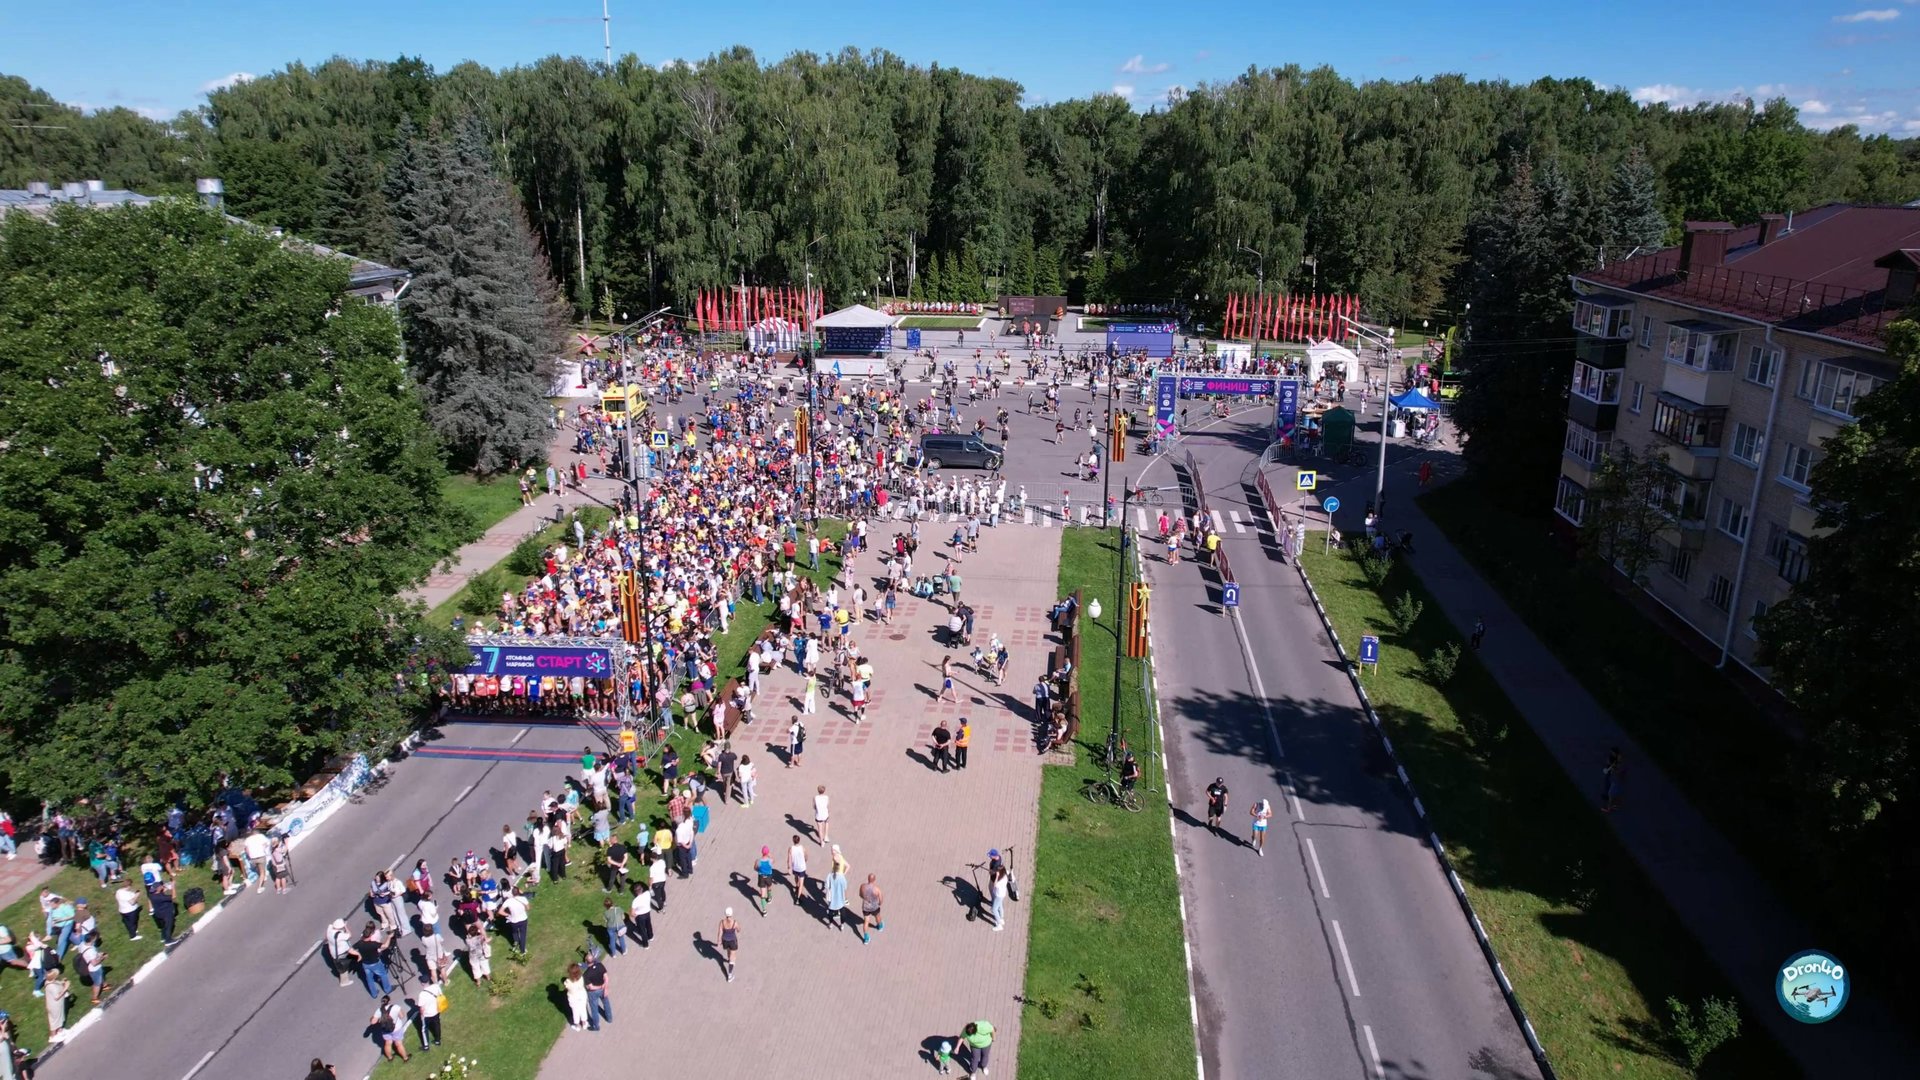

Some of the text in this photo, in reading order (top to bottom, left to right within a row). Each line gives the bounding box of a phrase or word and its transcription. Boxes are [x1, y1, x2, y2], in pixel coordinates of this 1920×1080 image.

[1207, 381, 1249, 392] ФИНИШ
[482, 647, 500, 673] 7
[536, 655, 583, 669] СТАРТ
